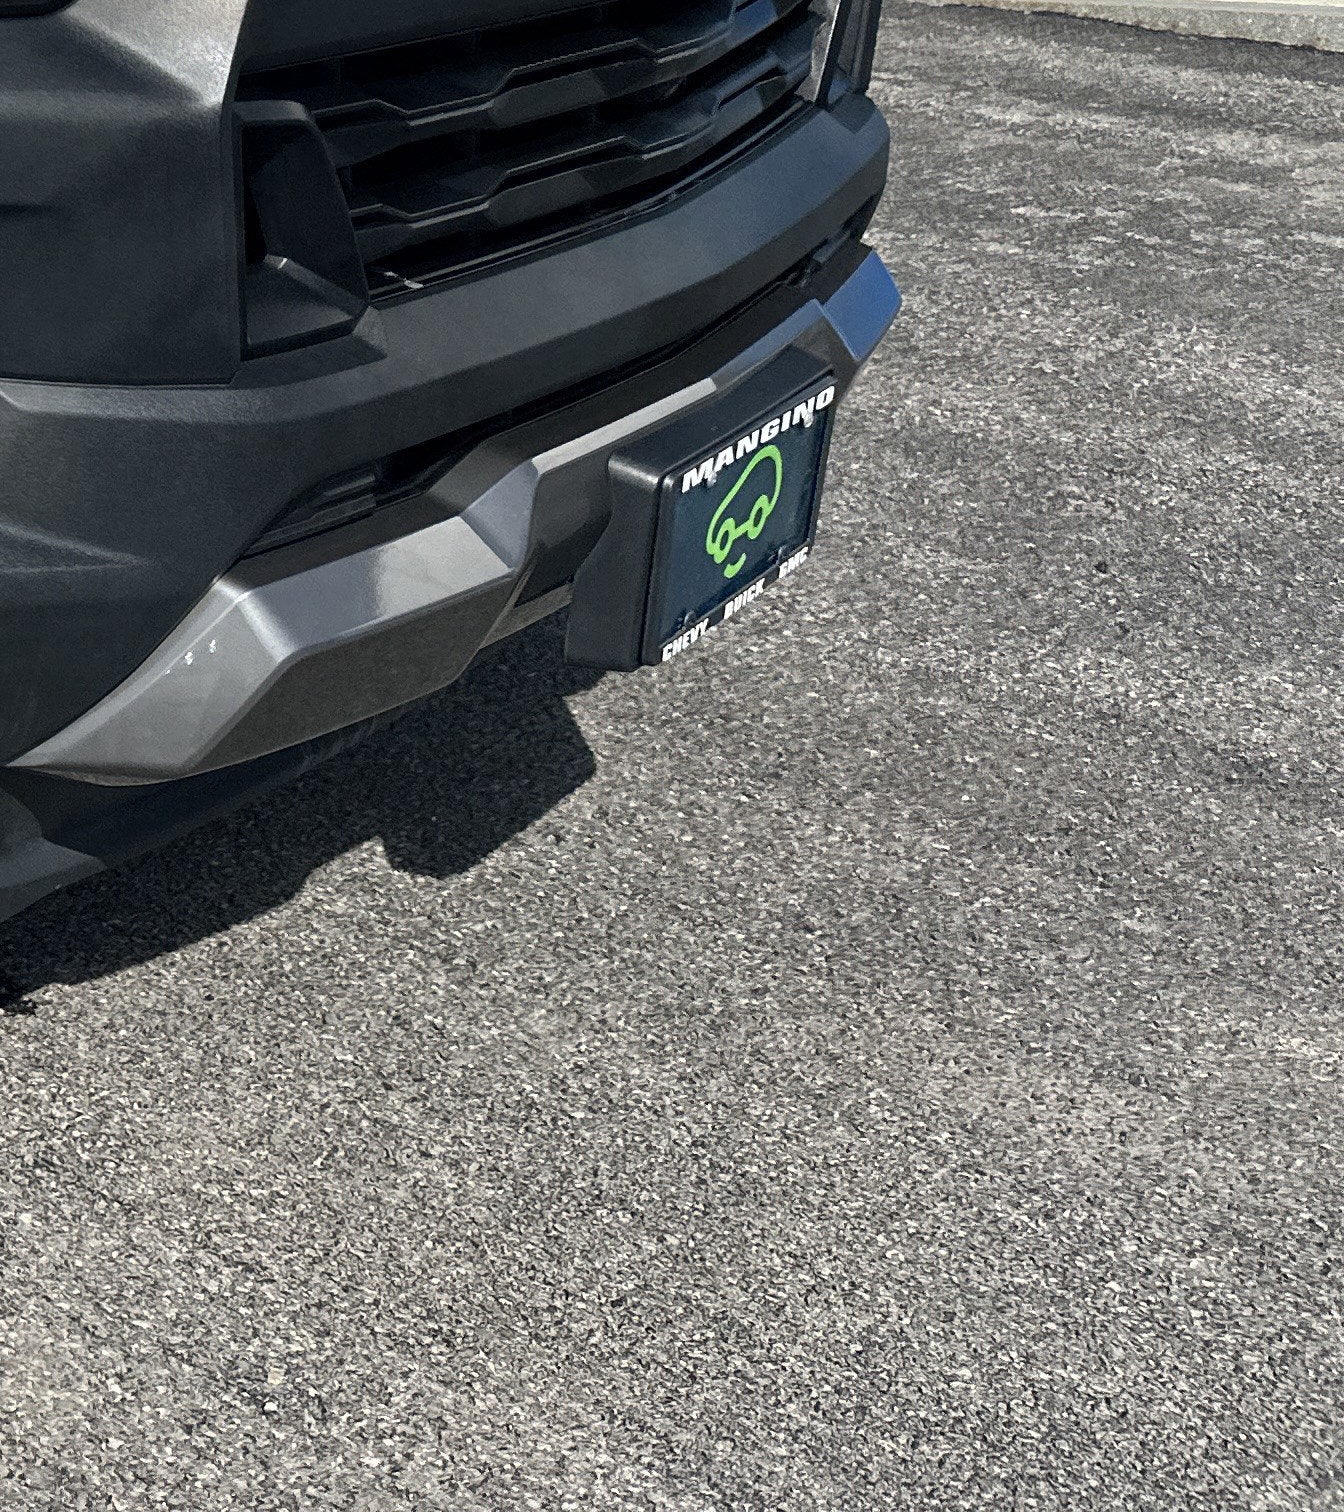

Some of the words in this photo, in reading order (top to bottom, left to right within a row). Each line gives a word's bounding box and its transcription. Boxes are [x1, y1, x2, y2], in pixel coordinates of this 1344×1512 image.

[681, 385, 835, 493] MANGINO
[662, 617, 709, 662] CHEVY
[723, 577, 766, 620] BUICK
[779, 546, 809, 579] GMC
